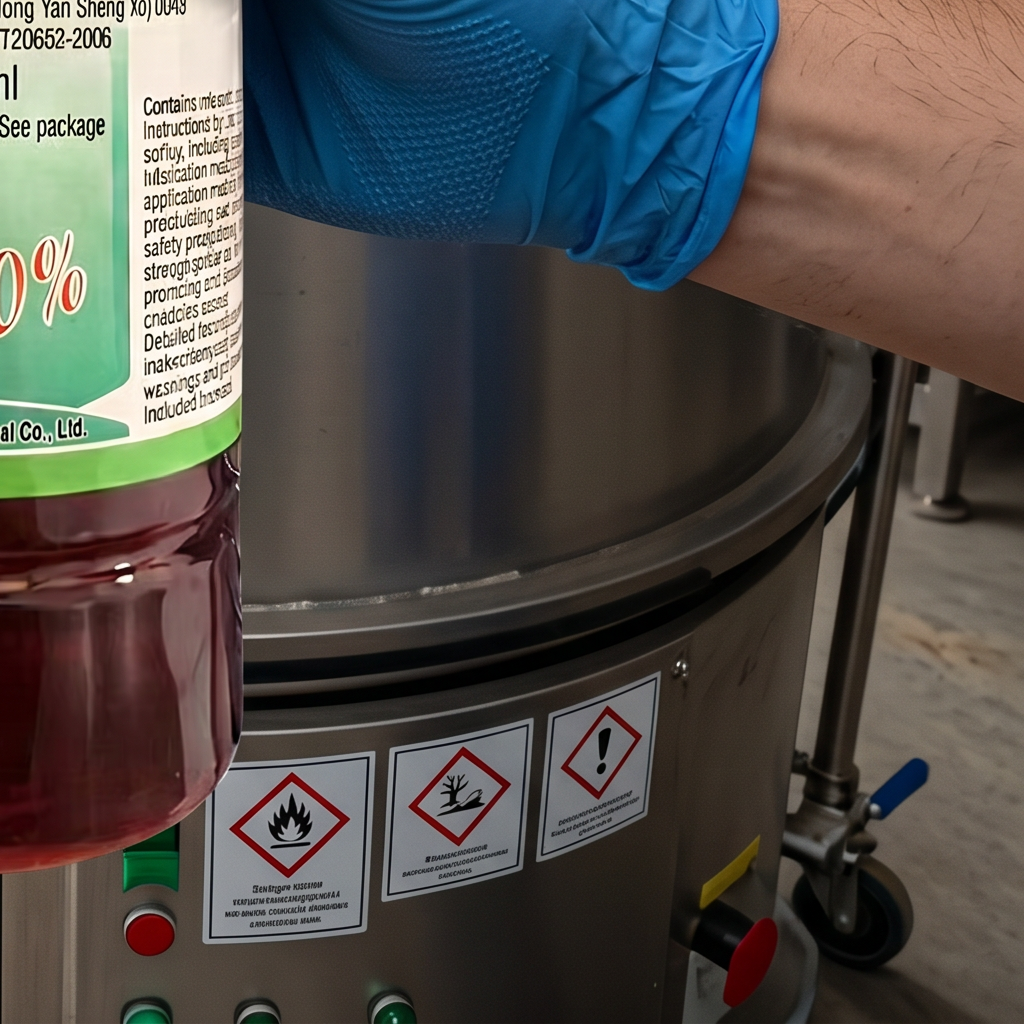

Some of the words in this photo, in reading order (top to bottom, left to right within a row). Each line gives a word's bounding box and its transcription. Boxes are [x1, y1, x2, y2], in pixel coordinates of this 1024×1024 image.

[143, 94, 197, 116] Contains
[36, 113, 106, 143] package
[143, 236, 183, 258] safety
[19, 421, 52, 443] Co.,
